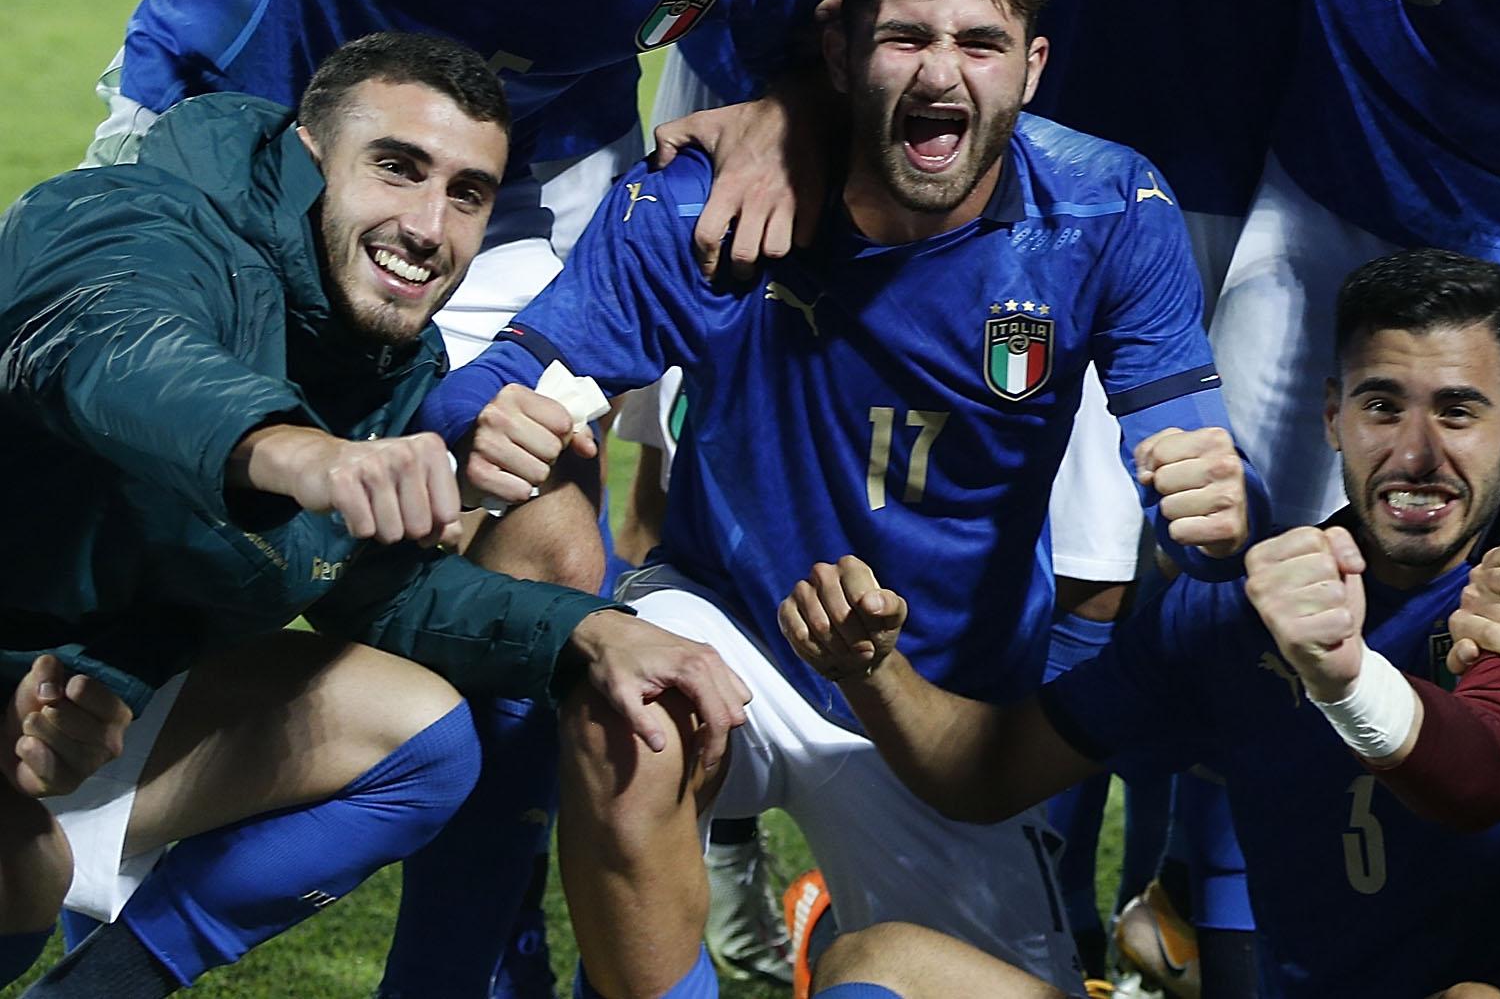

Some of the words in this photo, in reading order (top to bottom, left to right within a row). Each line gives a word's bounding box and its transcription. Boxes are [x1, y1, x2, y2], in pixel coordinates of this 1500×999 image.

[991, 322, 1047, 336] ITALIA
[867, 406, 950, 511] 17
[1342, 774, 1387, 894] 3
